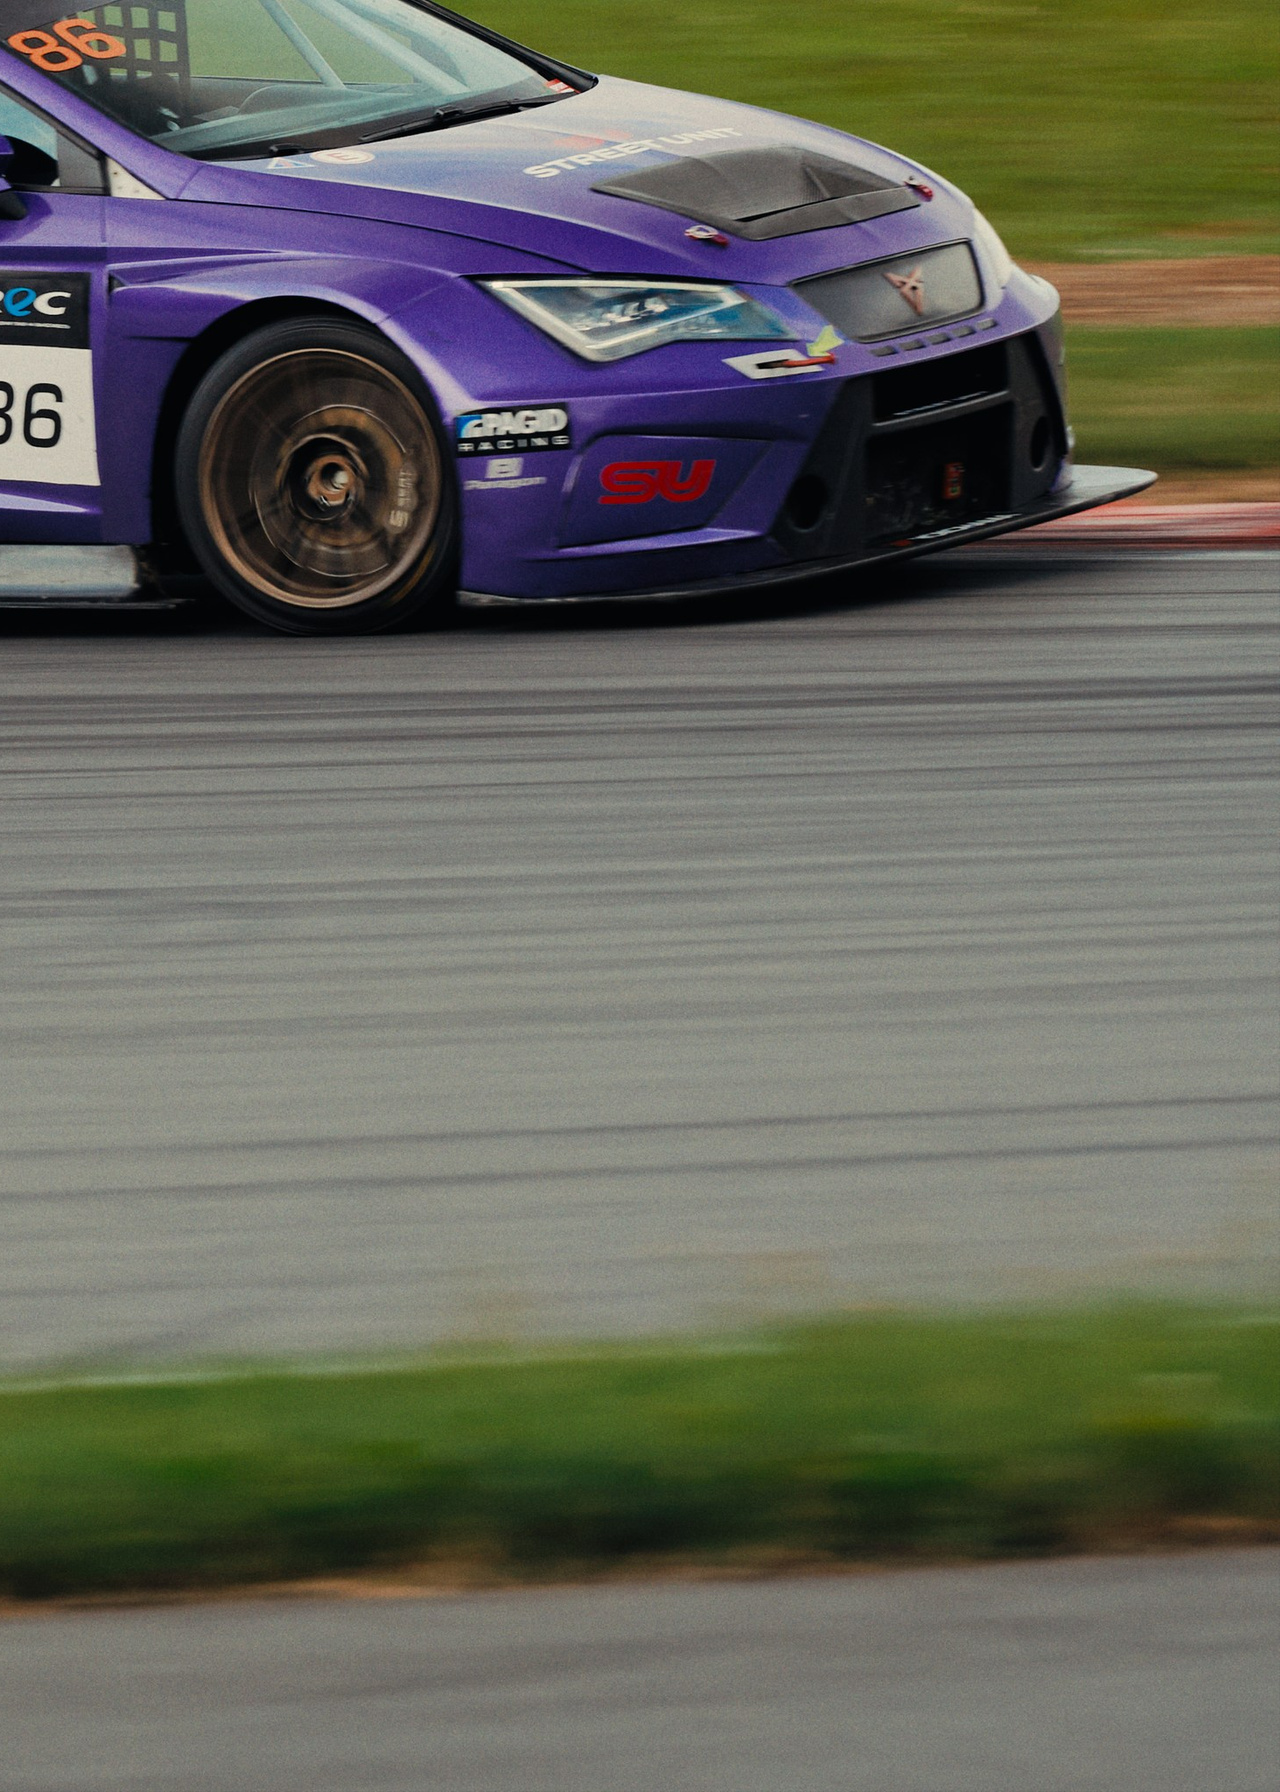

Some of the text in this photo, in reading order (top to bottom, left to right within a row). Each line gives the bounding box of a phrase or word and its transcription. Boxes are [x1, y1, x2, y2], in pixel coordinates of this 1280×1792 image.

[7, 18, 127, 72] 86
[522, 138, 663, 179] STREET
[657, 127, 743, 146] UNIT
[457, 435, 570, 453] RACING
[597, 459, 717, 505] SU
